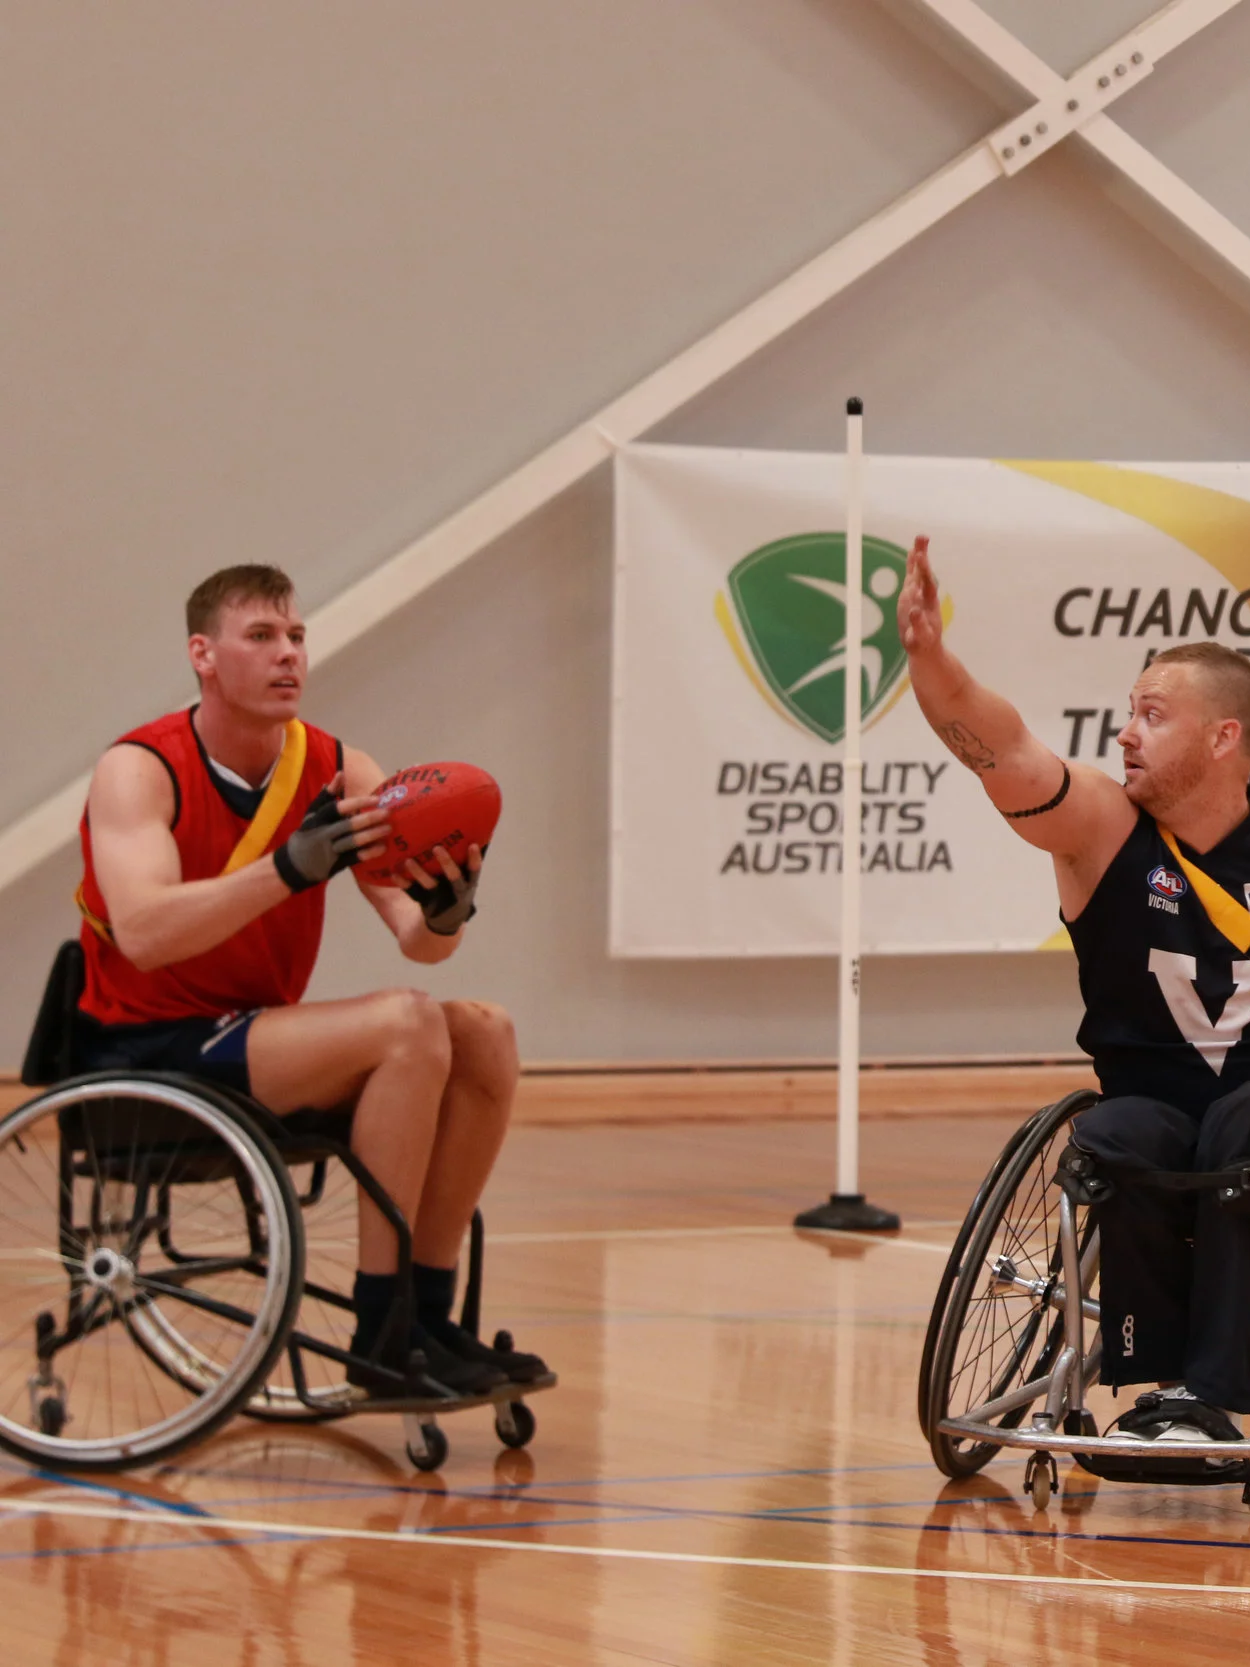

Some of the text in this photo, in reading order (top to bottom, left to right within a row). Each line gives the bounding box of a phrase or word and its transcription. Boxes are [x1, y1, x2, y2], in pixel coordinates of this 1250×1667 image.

[717, 762, 948, 796] DISABLITY
[394, 835, 409, 852] 5
[1151, 870, 1183, 893] AFL
[1148, 893, 1179, 915] VICTORIA
